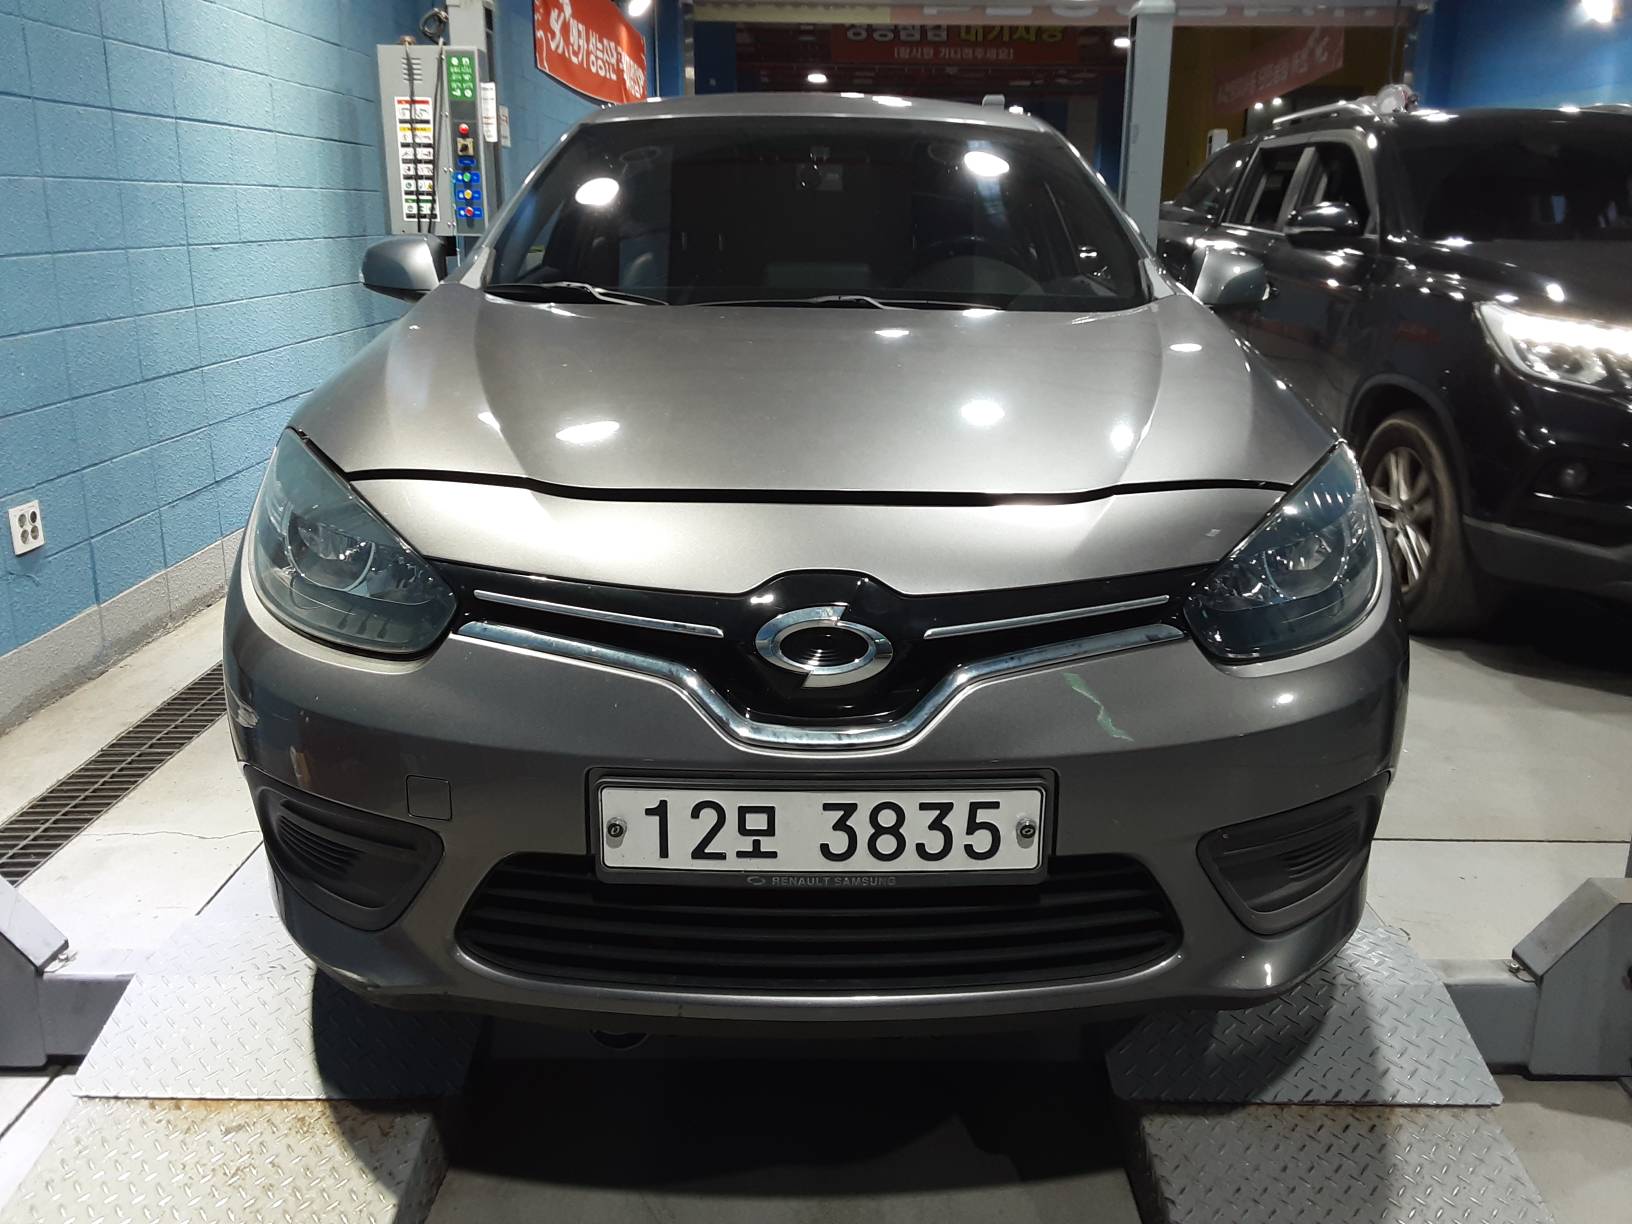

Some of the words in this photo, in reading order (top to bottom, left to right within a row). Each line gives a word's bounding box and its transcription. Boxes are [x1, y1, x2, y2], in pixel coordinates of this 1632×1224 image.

[644, 799, 778, 860] 12모
[819, 801, 1002, 862] 3835
[772, 876, 831, 886] RENAULT
[834, 876, 897, 886] SAMSUNG
